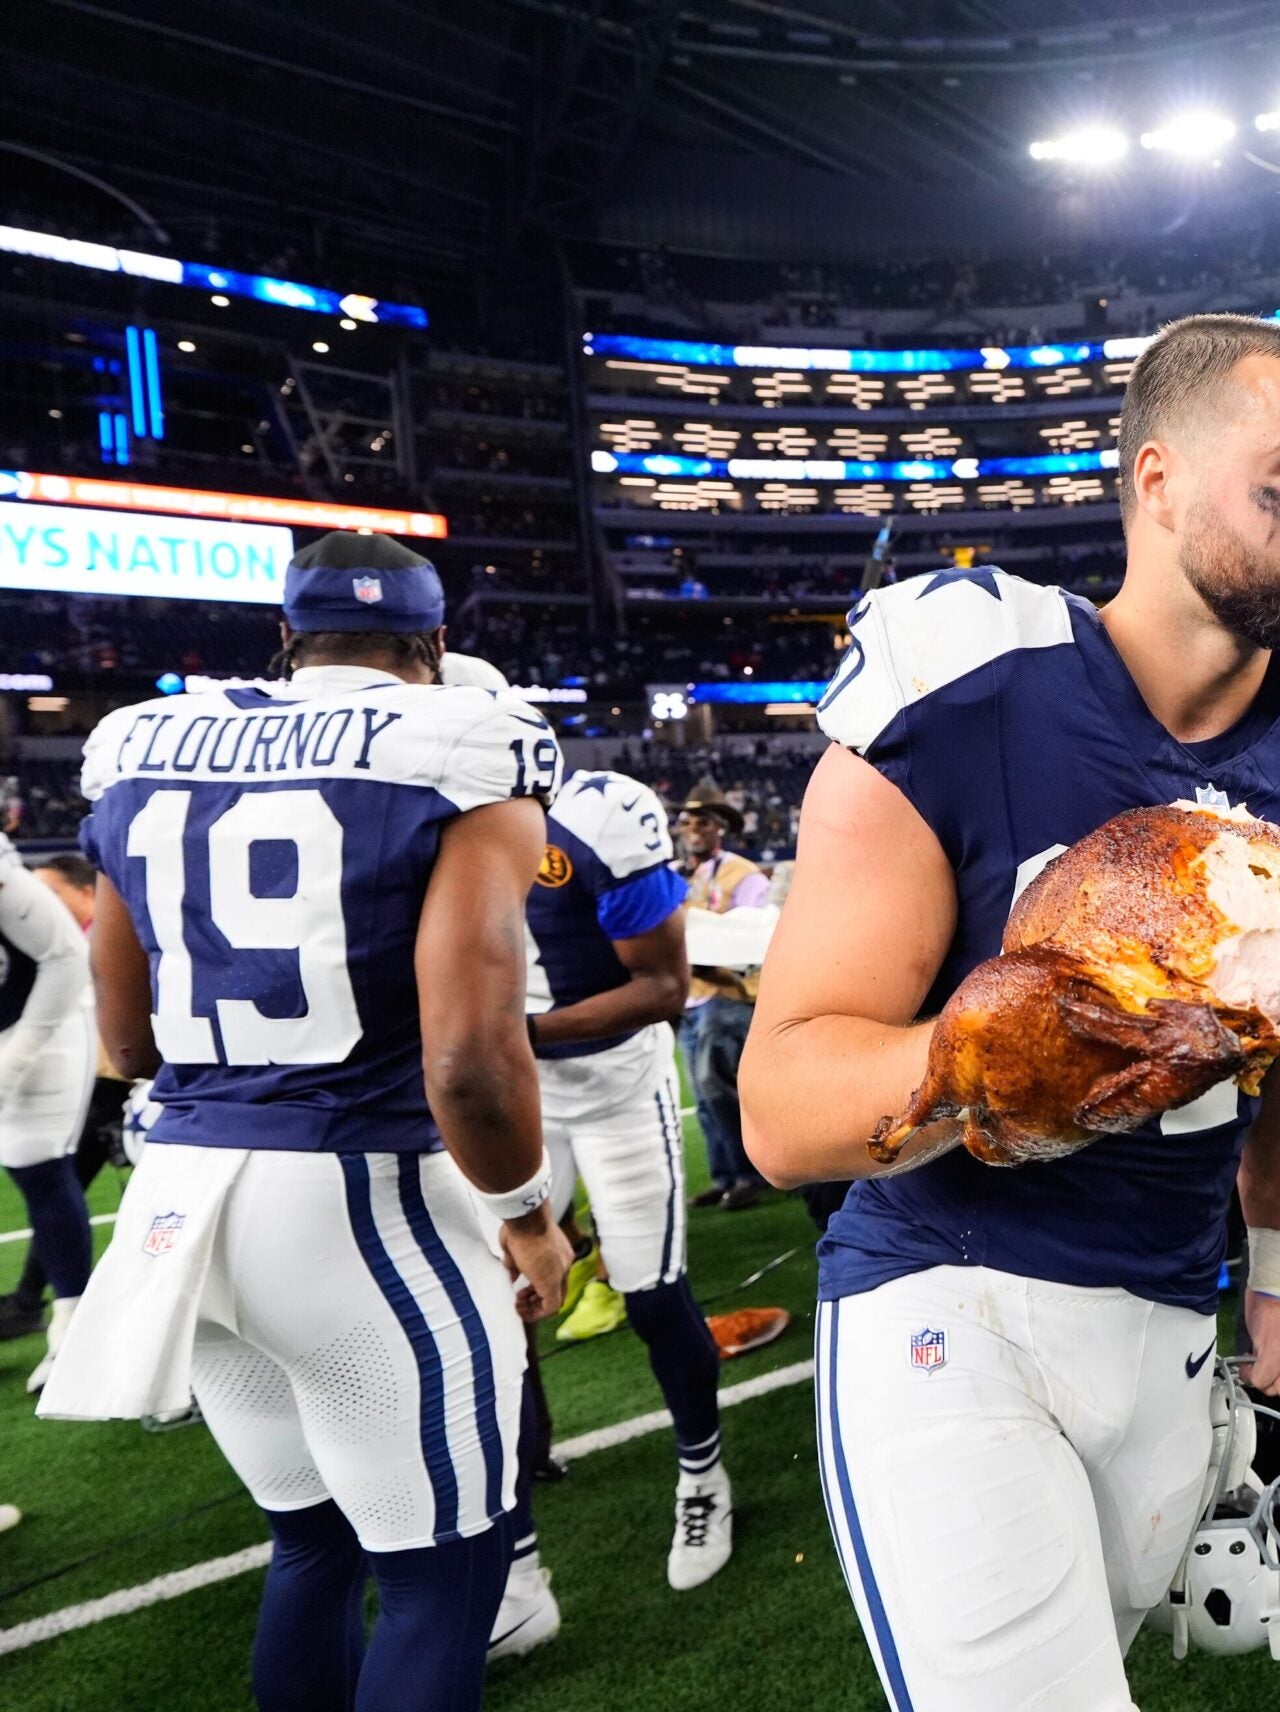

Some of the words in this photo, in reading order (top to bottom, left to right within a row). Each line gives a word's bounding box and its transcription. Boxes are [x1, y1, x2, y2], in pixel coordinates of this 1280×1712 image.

[0, 523, 70, 568] YS
[86, 530, 277, 582] NATION
[116, 707, 403, 773] FLOURNOY
[509, 738, 558, 798] 19
[640, 812, 662, 851] 3
[126, 789, 364, 1067] 19
[144, 1230, 175, 1252] NFL
[914, 1345, 943, 1366] NFL
